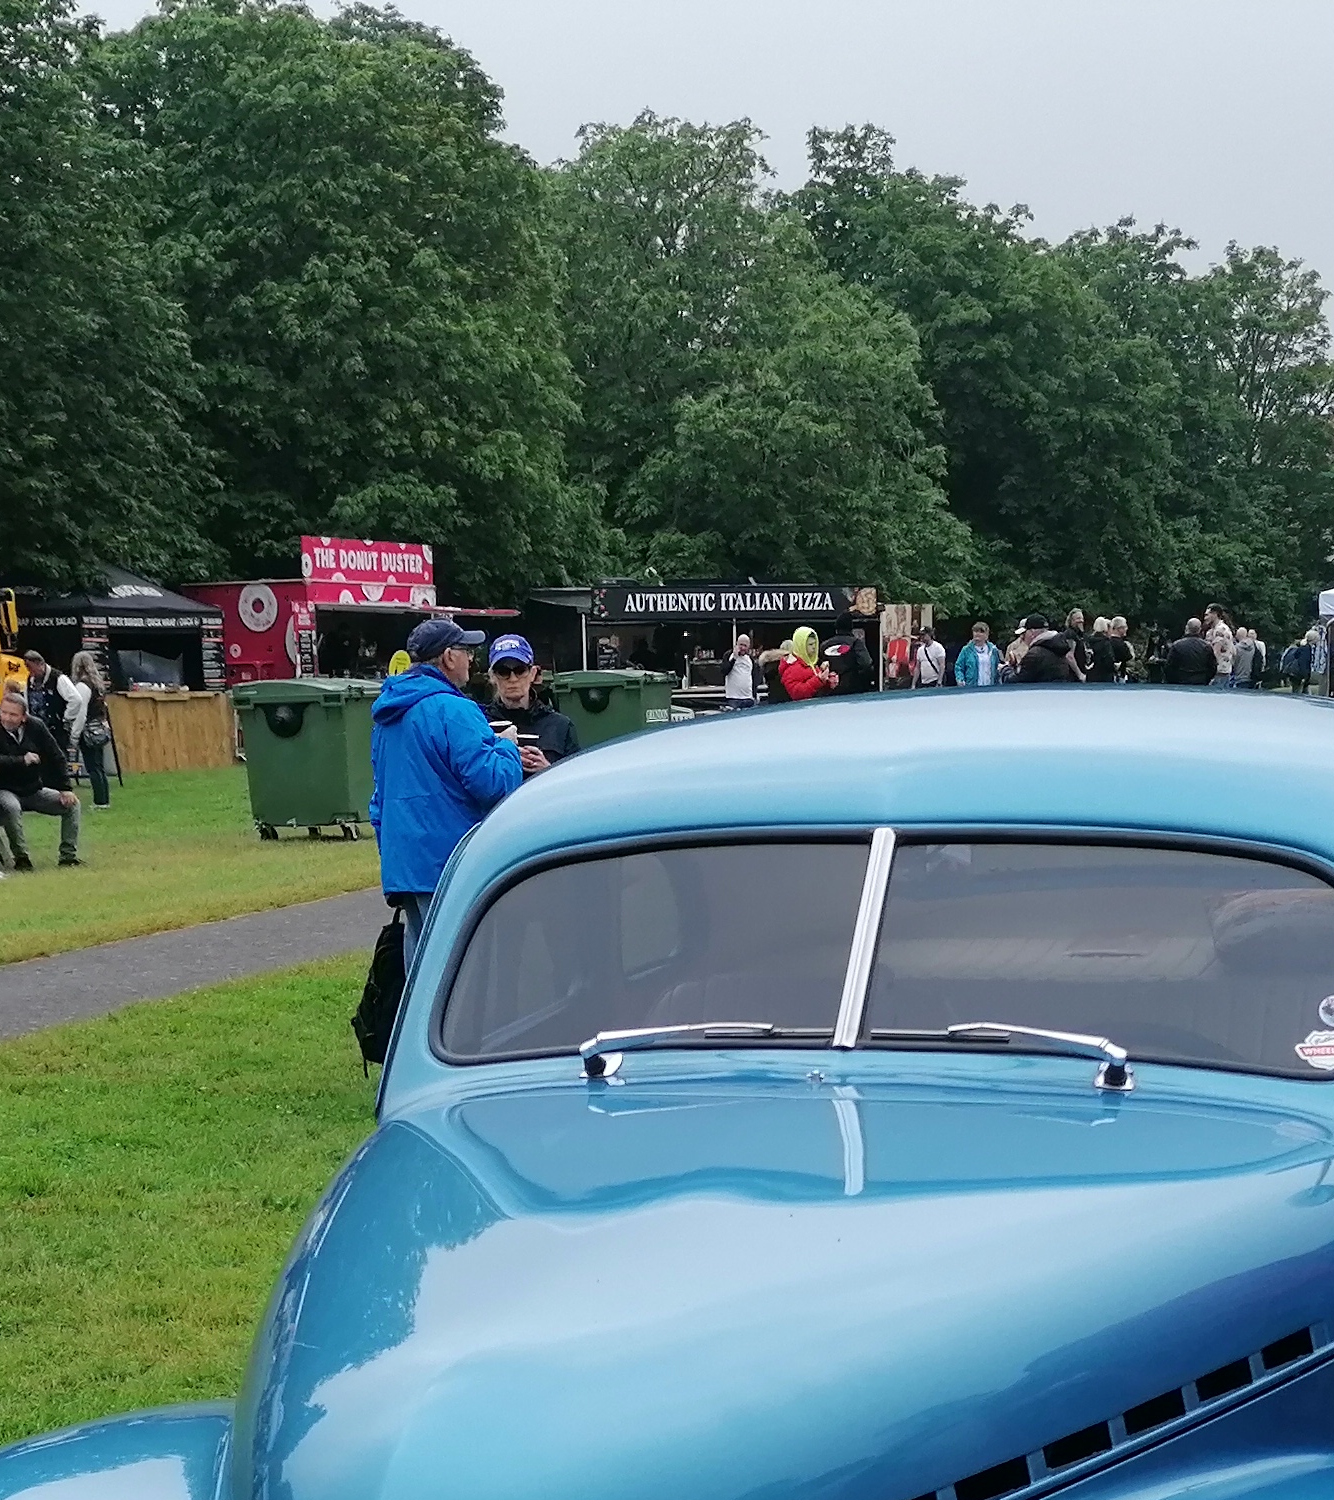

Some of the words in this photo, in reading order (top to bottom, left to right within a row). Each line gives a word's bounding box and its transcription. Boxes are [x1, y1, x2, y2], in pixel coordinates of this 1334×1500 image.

[314, 547, 336, 569] THE
[339, 549, 379, 572] DONUT
[381, 552, 423, 574] DUSTER
[624, 592, 716, 613] AUTHENTIC
[720, 592, 784, 612] ITALIAN
[788, 592, 835, 611] PIZZA
[34, 617, 55, 627] DUCK
[55, 616, 78, 626] SALAD
